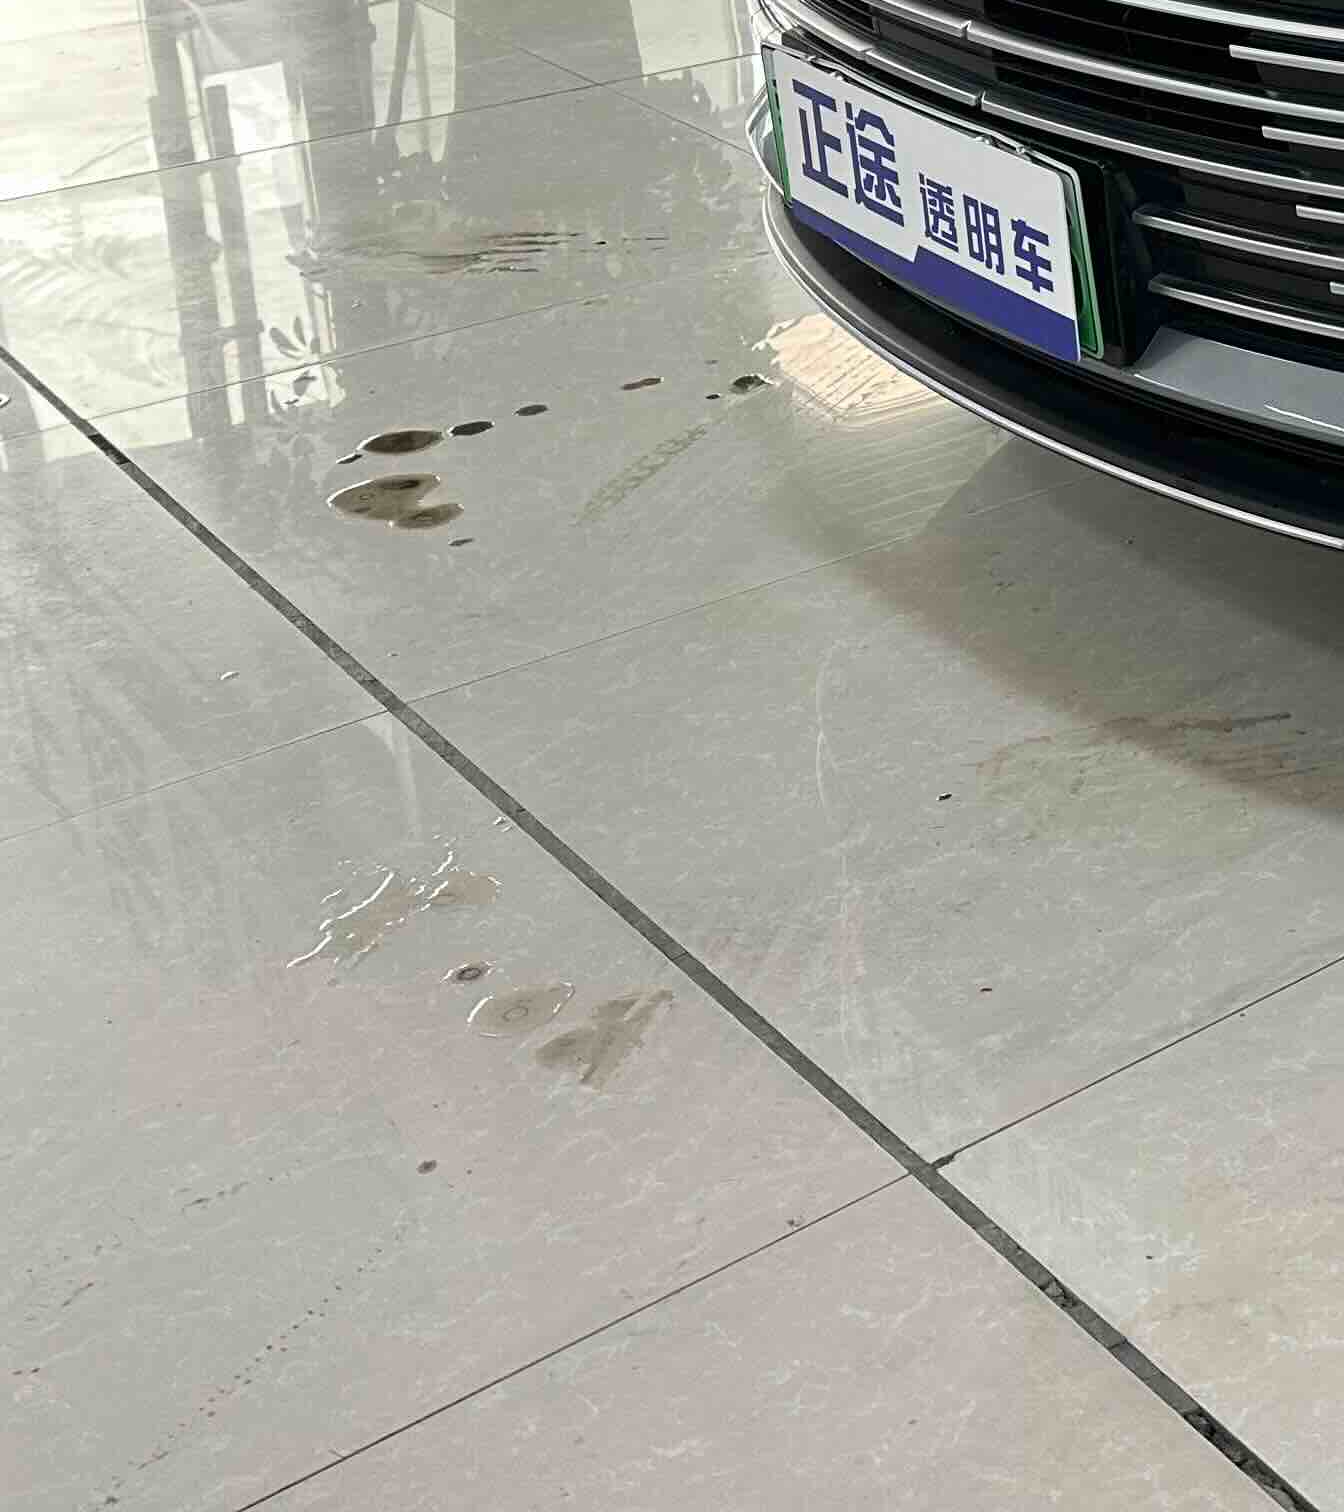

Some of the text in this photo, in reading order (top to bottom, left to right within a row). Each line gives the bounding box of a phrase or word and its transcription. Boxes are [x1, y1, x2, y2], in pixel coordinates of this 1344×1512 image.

[792, 79, 1054, 292] 正途 透明车
